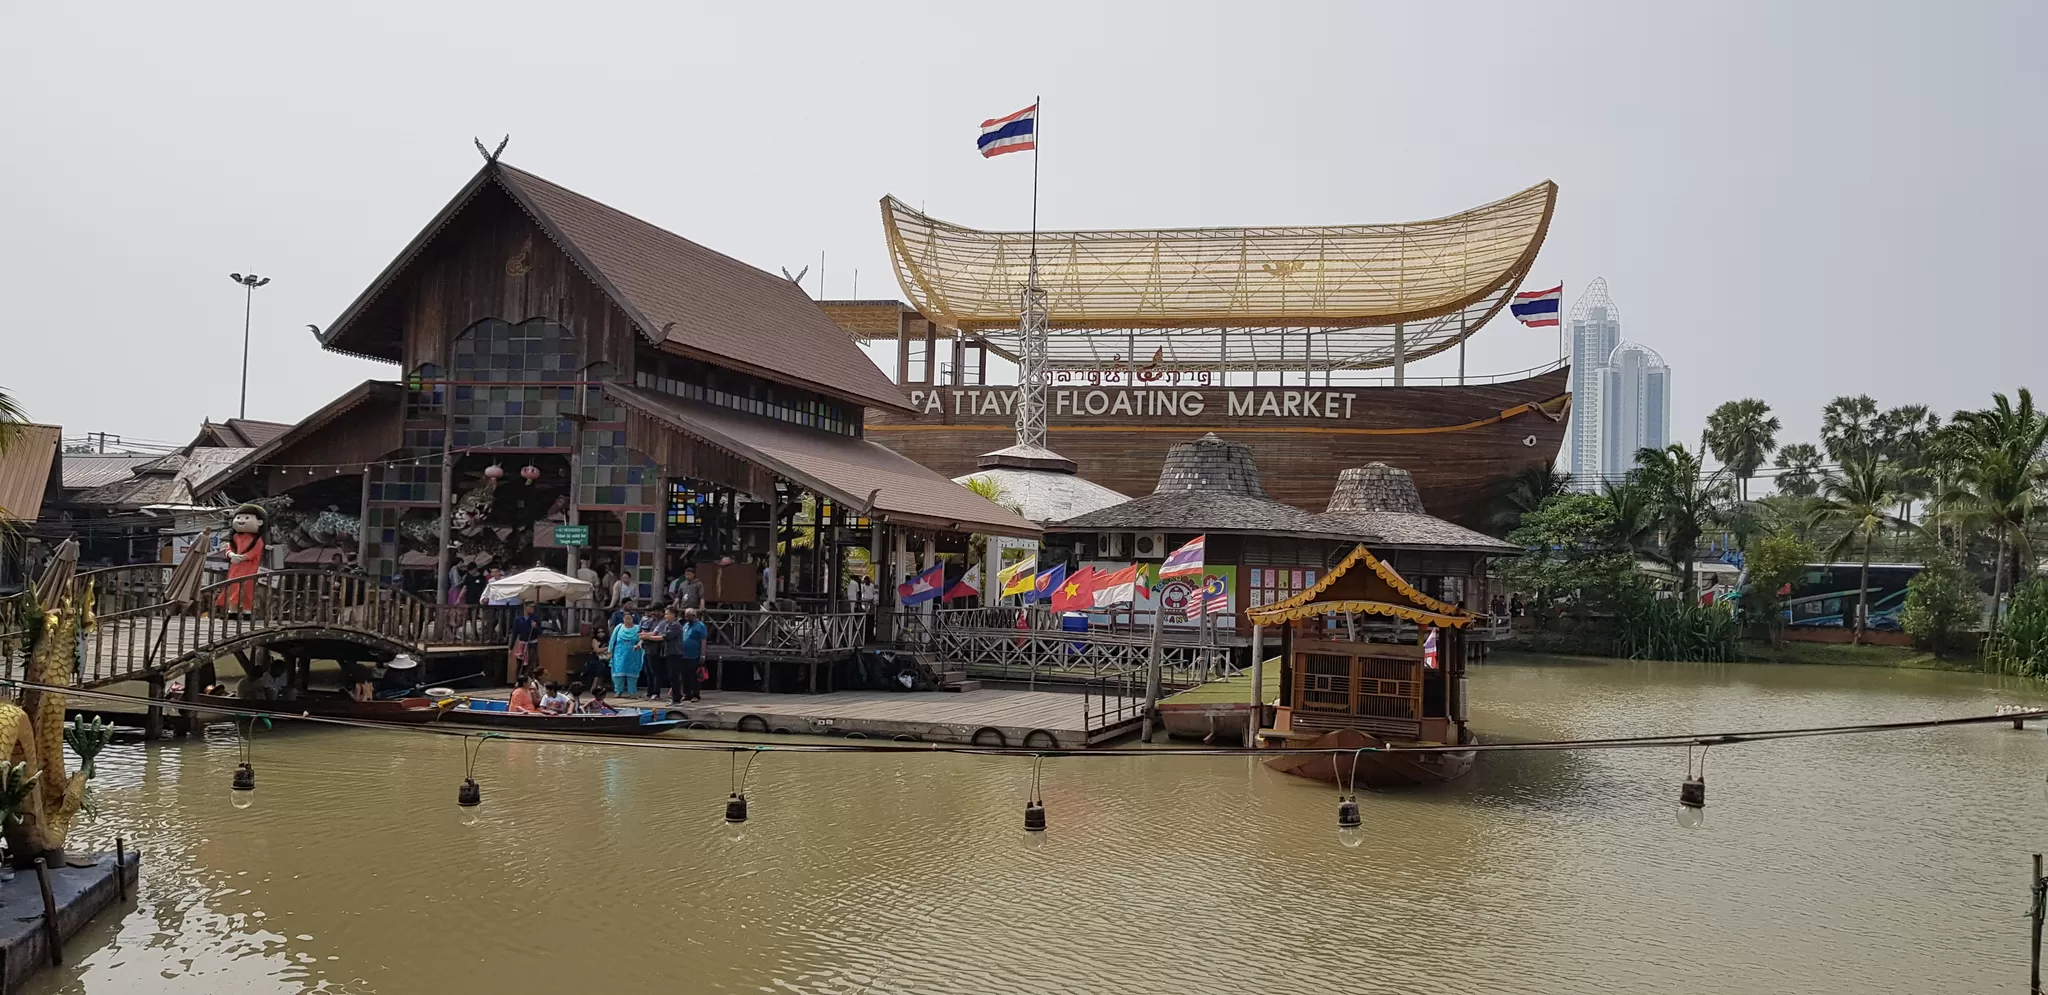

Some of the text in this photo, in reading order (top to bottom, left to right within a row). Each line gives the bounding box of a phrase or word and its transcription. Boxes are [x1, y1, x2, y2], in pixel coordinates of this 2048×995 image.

[911, 390, 1357, 419] PATTAY FLOATING MARKET
